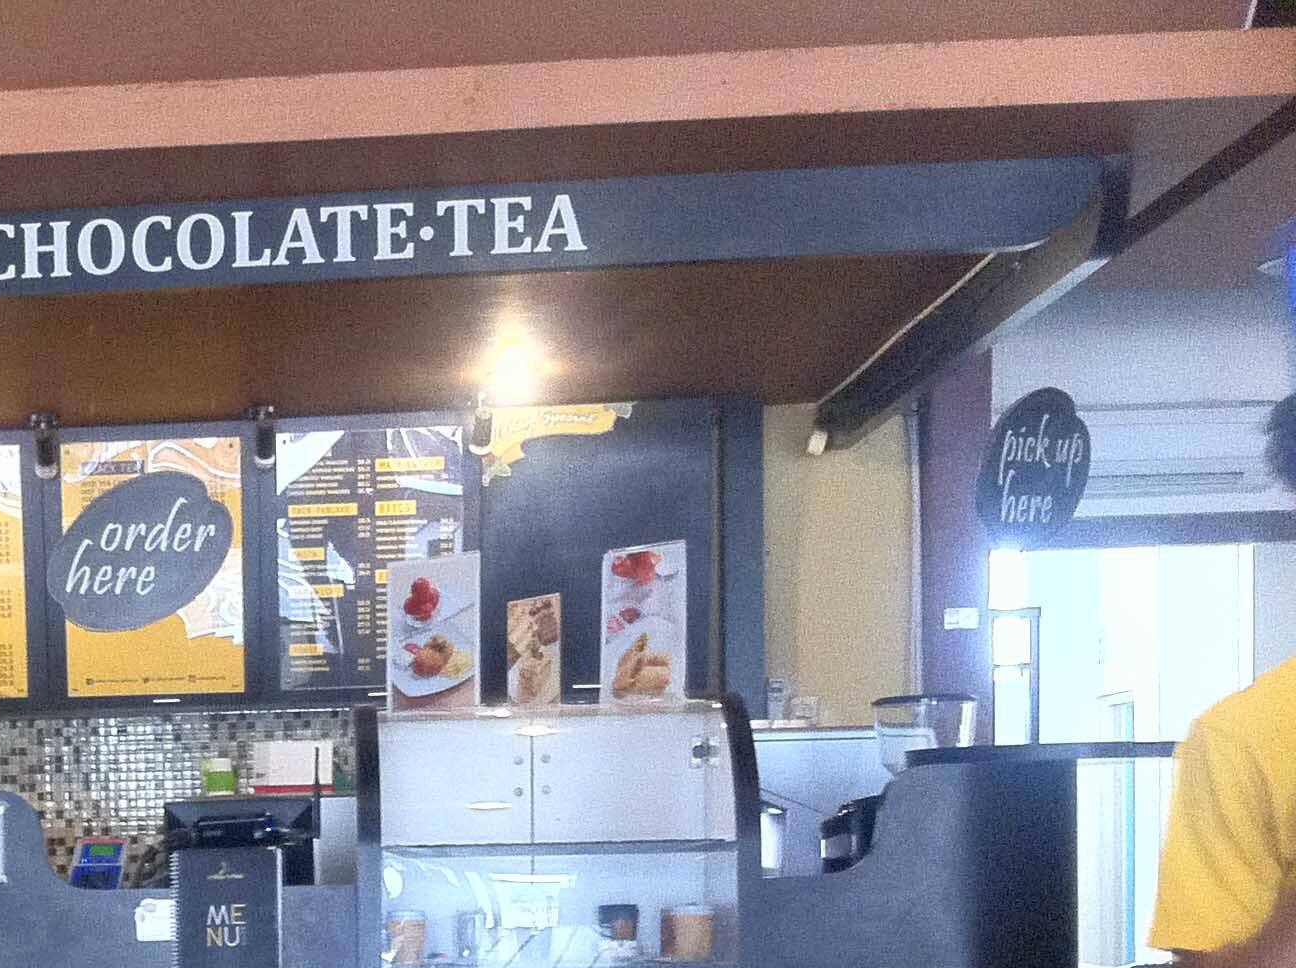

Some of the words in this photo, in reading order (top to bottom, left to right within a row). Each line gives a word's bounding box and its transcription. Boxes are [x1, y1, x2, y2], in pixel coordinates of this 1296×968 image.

[998, 413, 1051, 486] pick
[1055, 433, 1084, 488] up
[1001, 469, 1054, 523] here
[100, 497, 217, 553] order
[65, 539, 156, 596] here
[206, 903, 247, 926] ME
[206, 926, 241, 947] NU
